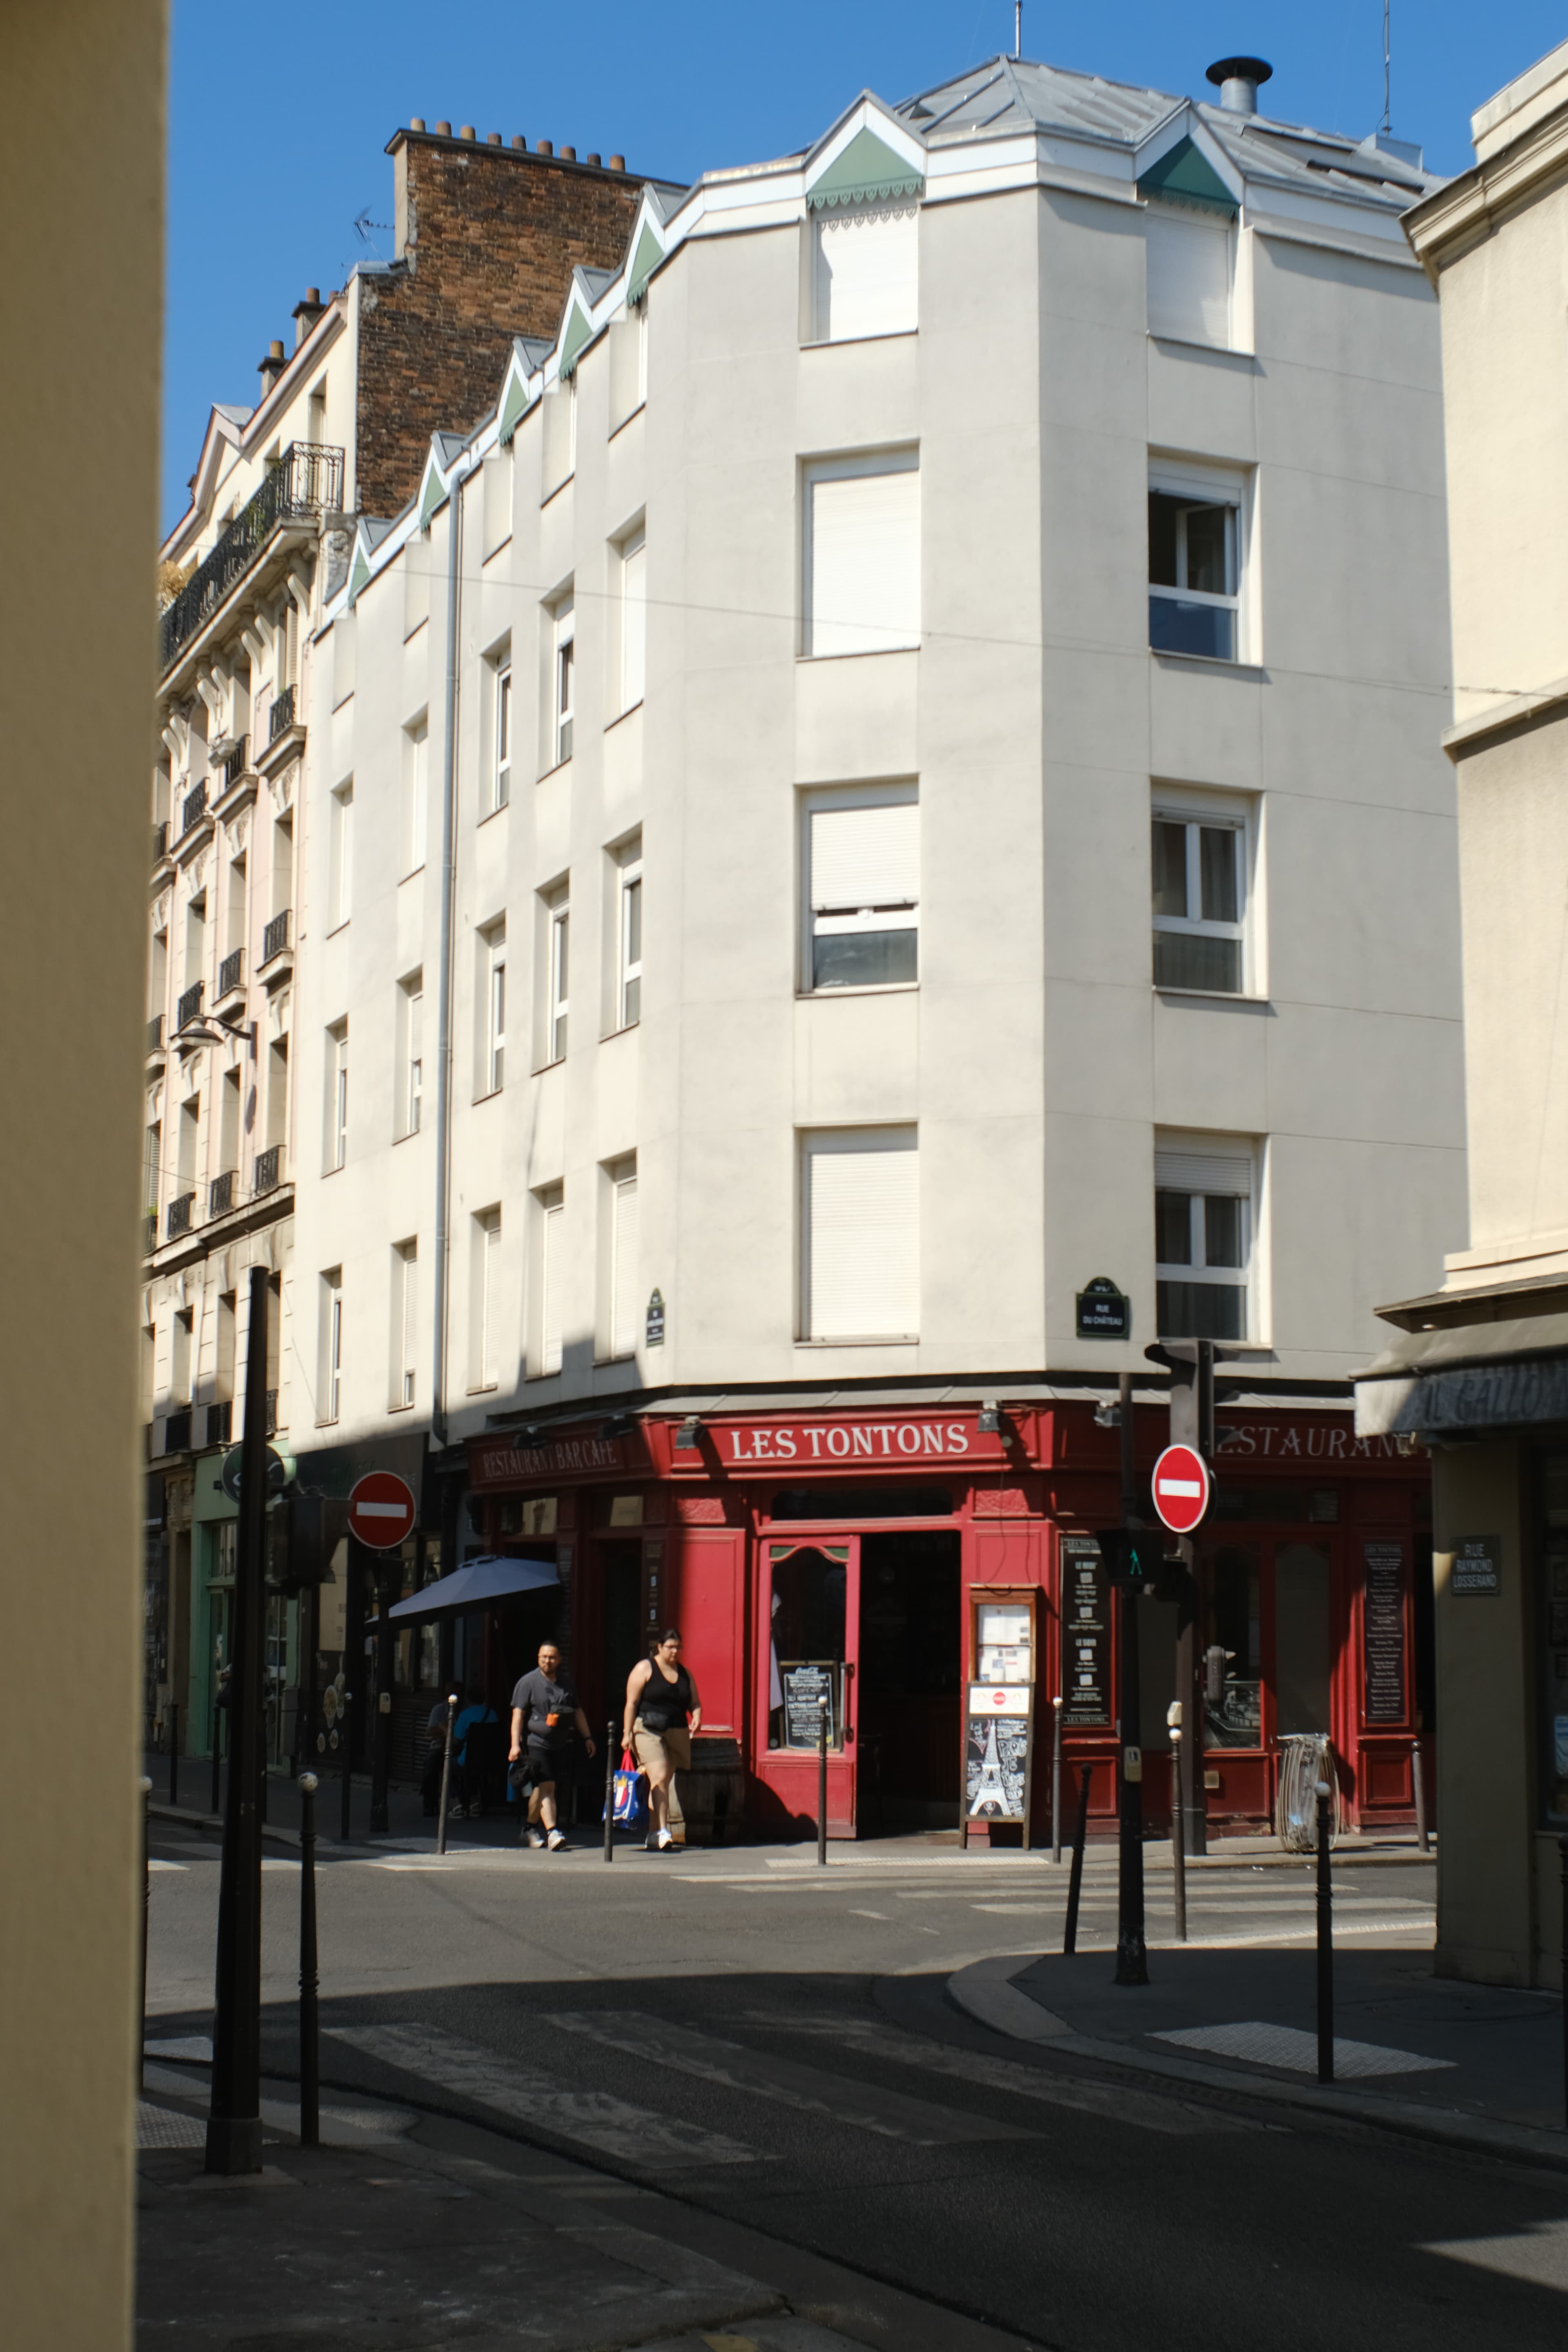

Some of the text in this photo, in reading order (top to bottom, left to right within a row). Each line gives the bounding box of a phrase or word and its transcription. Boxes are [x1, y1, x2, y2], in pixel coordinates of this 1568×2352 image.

[731, 1424, 969, 1459] LES TONTONS
[1465, 1543, 1485, 1557] RUE
[1457, 1559, 1493, 1572] RAYMOND
[1453, 1574, 1497, 1588] LOSSERAND
